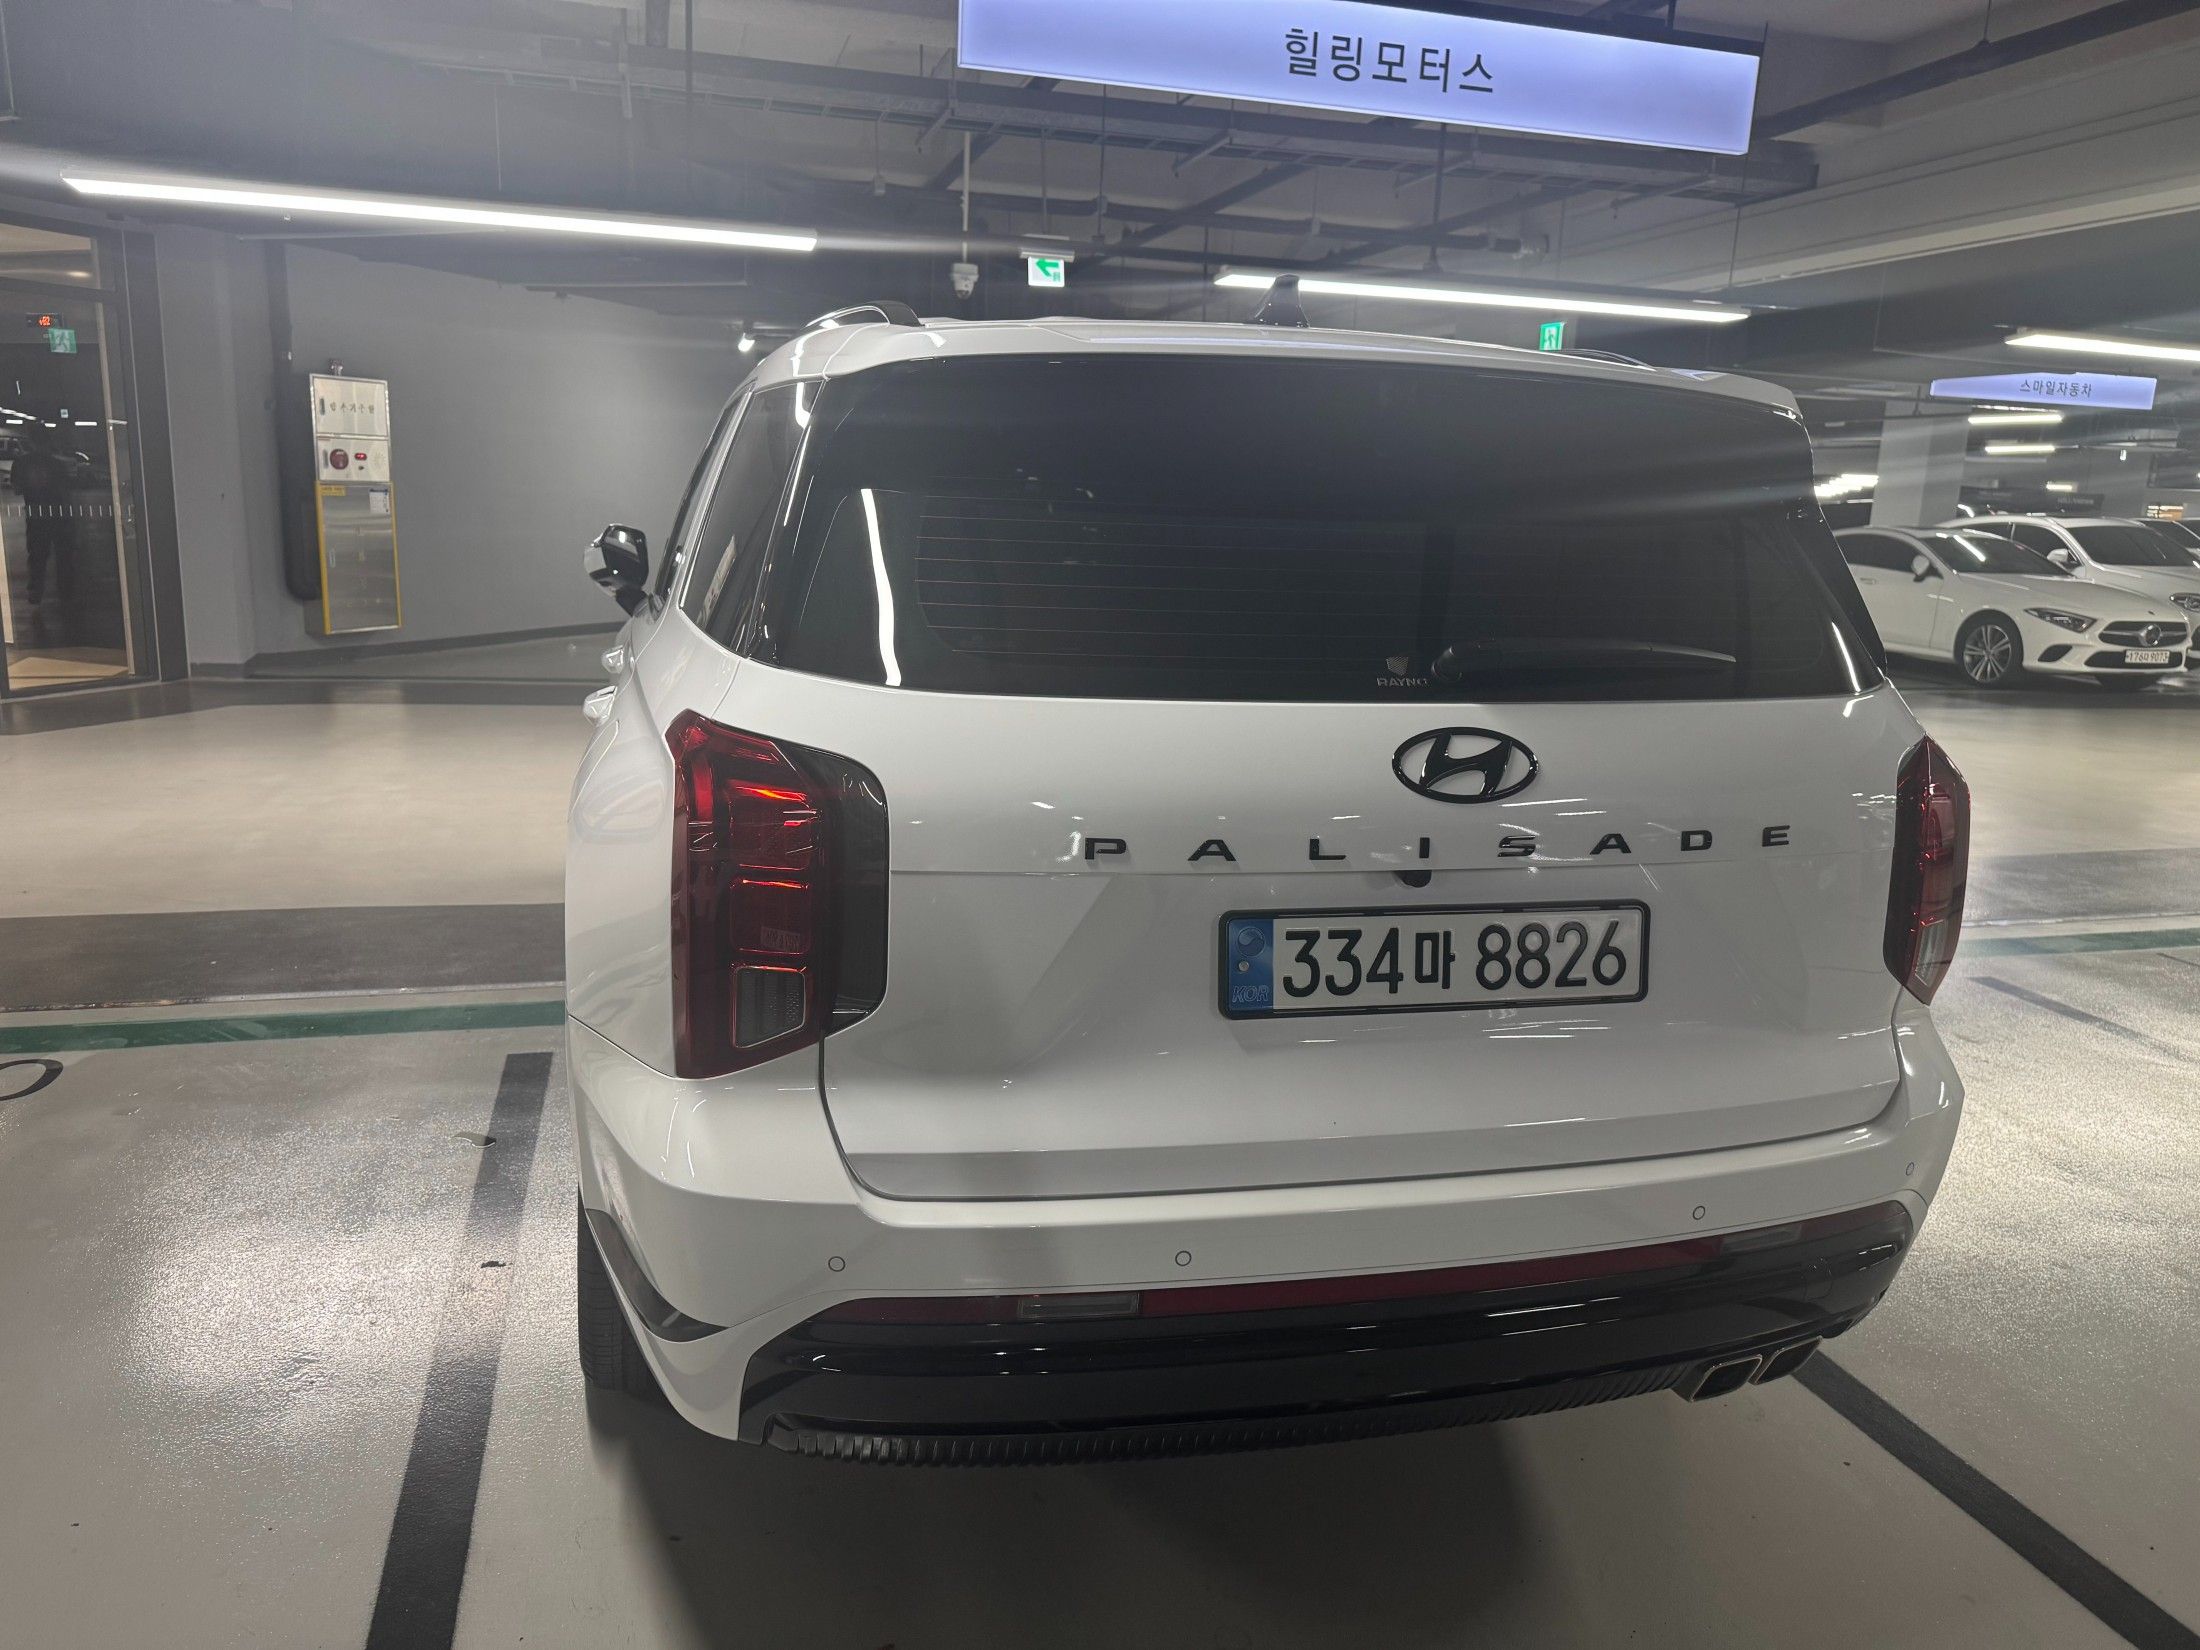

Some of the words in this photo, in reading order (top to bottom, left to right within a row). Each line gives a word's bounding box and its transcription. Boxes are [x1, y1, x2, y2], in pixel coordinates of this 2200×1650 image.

[1285, 27, 1494, 94] 힐링모터스
[2019, 379, 2092, 398] 스마일자동차
[1084, 824, 1791, 863] PALISADE
[1281, 926, 1456, 998] 334마
[1475, 918, 1627, 991] 8826
[1231, 985, 1271, 1003] KOR
